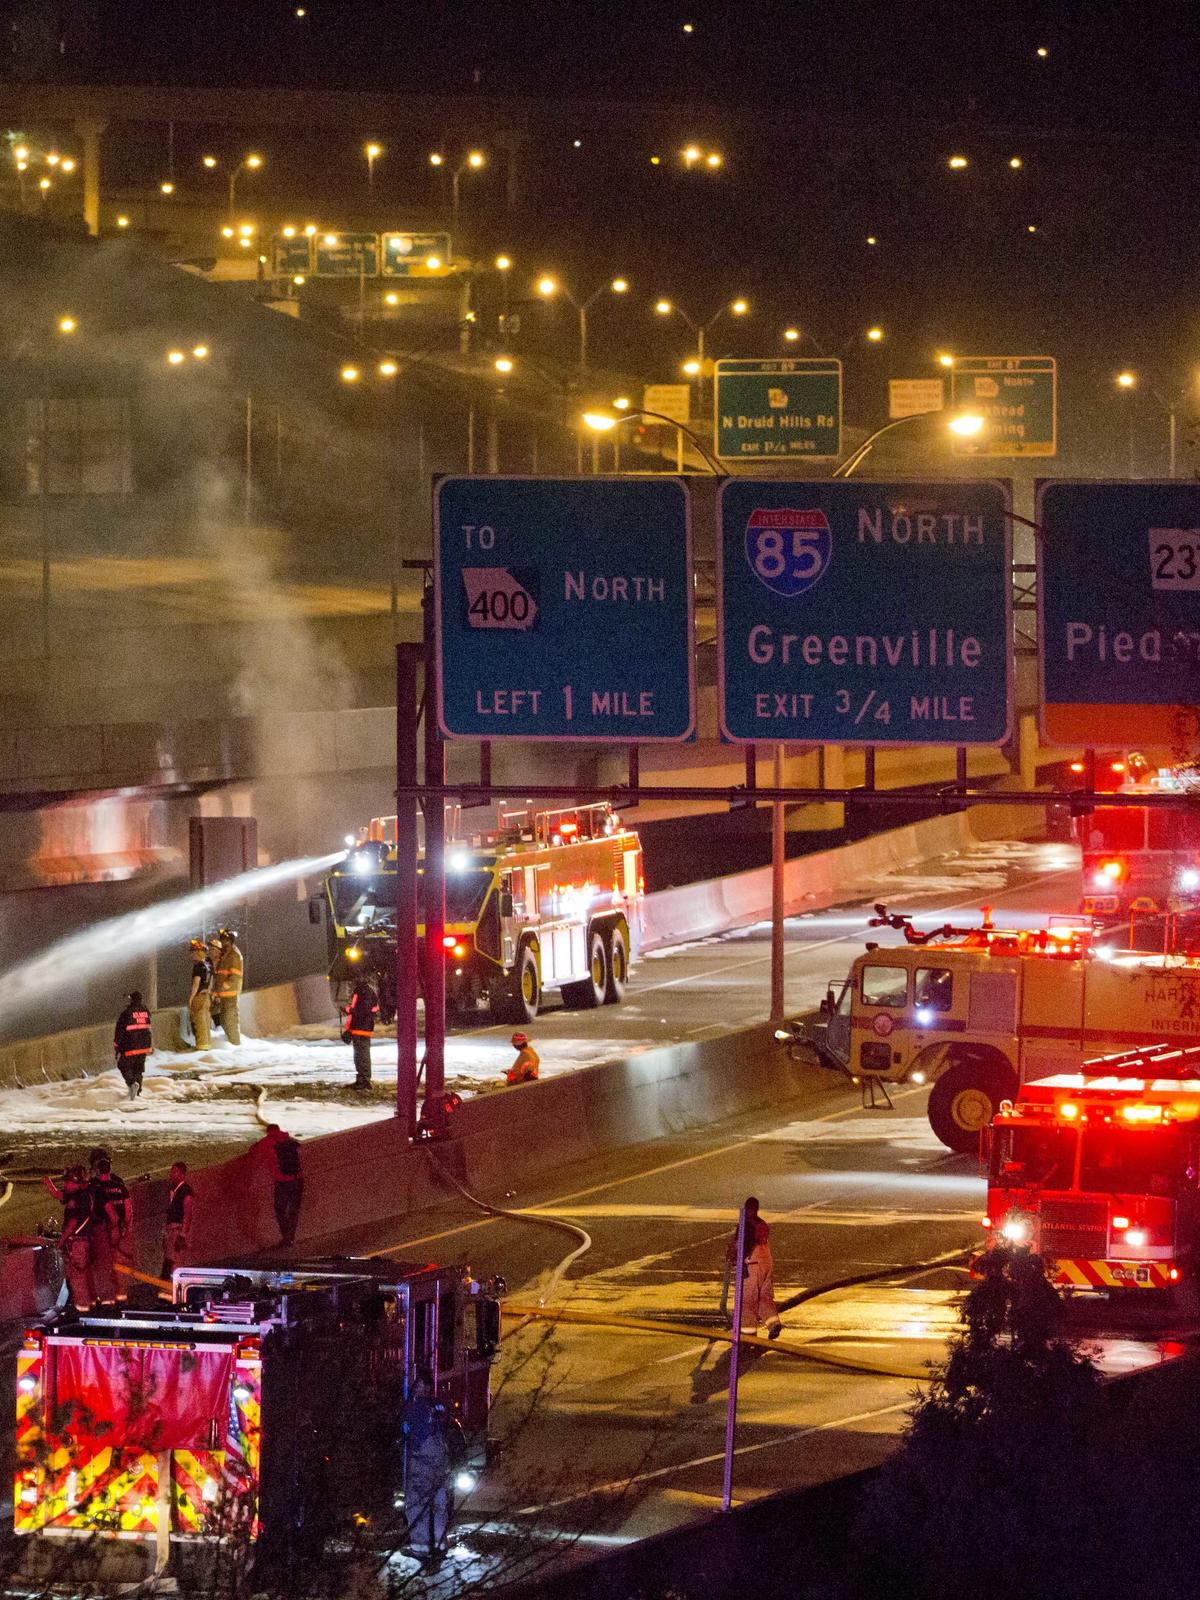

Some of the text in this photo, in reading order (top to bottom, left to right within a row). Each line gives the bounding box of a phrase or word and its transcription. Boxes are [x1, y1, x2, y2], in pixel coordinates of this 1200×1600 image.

[723, 415, 834, 428] N Druid Hills Rd
[759, 514, 817, 526] INTERSTATE
[857, 508, 984, 545] NORTH
[461, 525, 495, 550] TO
[755, 530, 822, 578] 85
[1154, 544, 1200, 580] 23
[564, 570, 665, 601] NORTH
[469, 590, 529, 621] 400
[748, 624, 982, 668] Greenville
[475, 685, 656, 720] LEFT 1 MILE
[754, 689, 975, 725] EXIT 3/4 MILE
[1042, 1222, 1075, 1231] ATLANTIC
